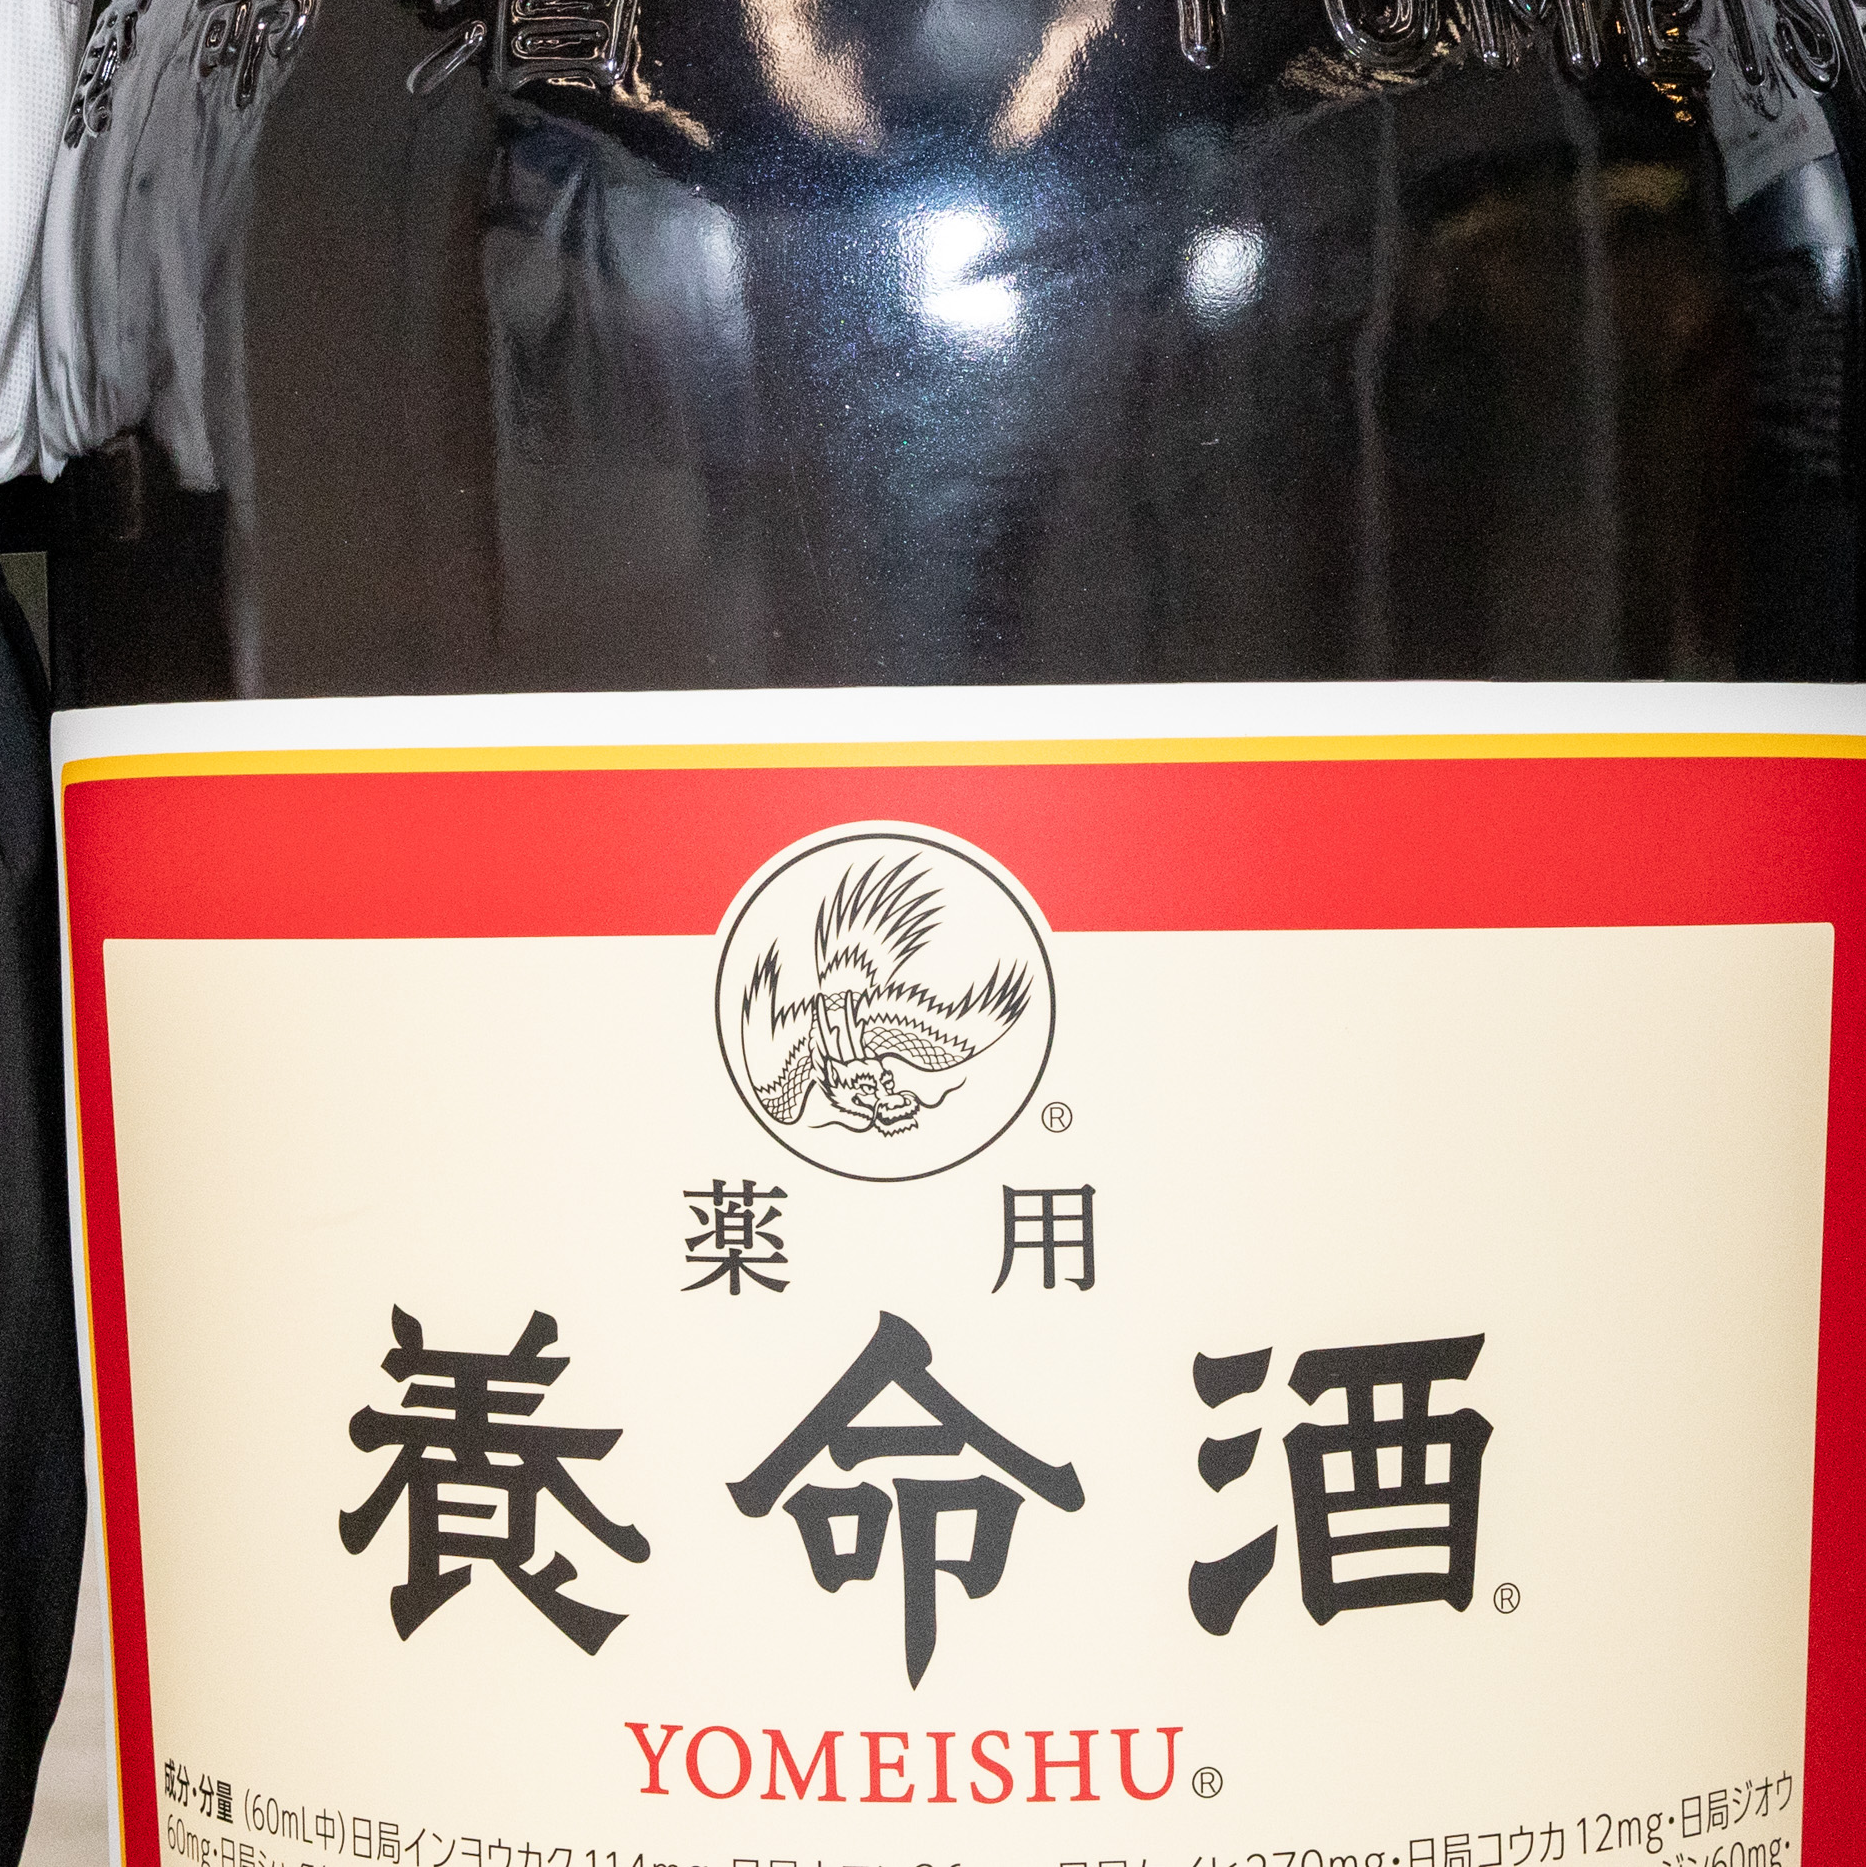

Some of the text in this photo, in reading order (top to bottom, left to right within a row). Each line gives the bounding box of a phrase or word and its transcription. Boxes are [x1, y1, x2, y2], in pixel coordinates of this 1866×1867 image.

[338, 1302, 1495, 1692] 養命酒
[624, 1721, 1184, 1803] YOMEISHU
